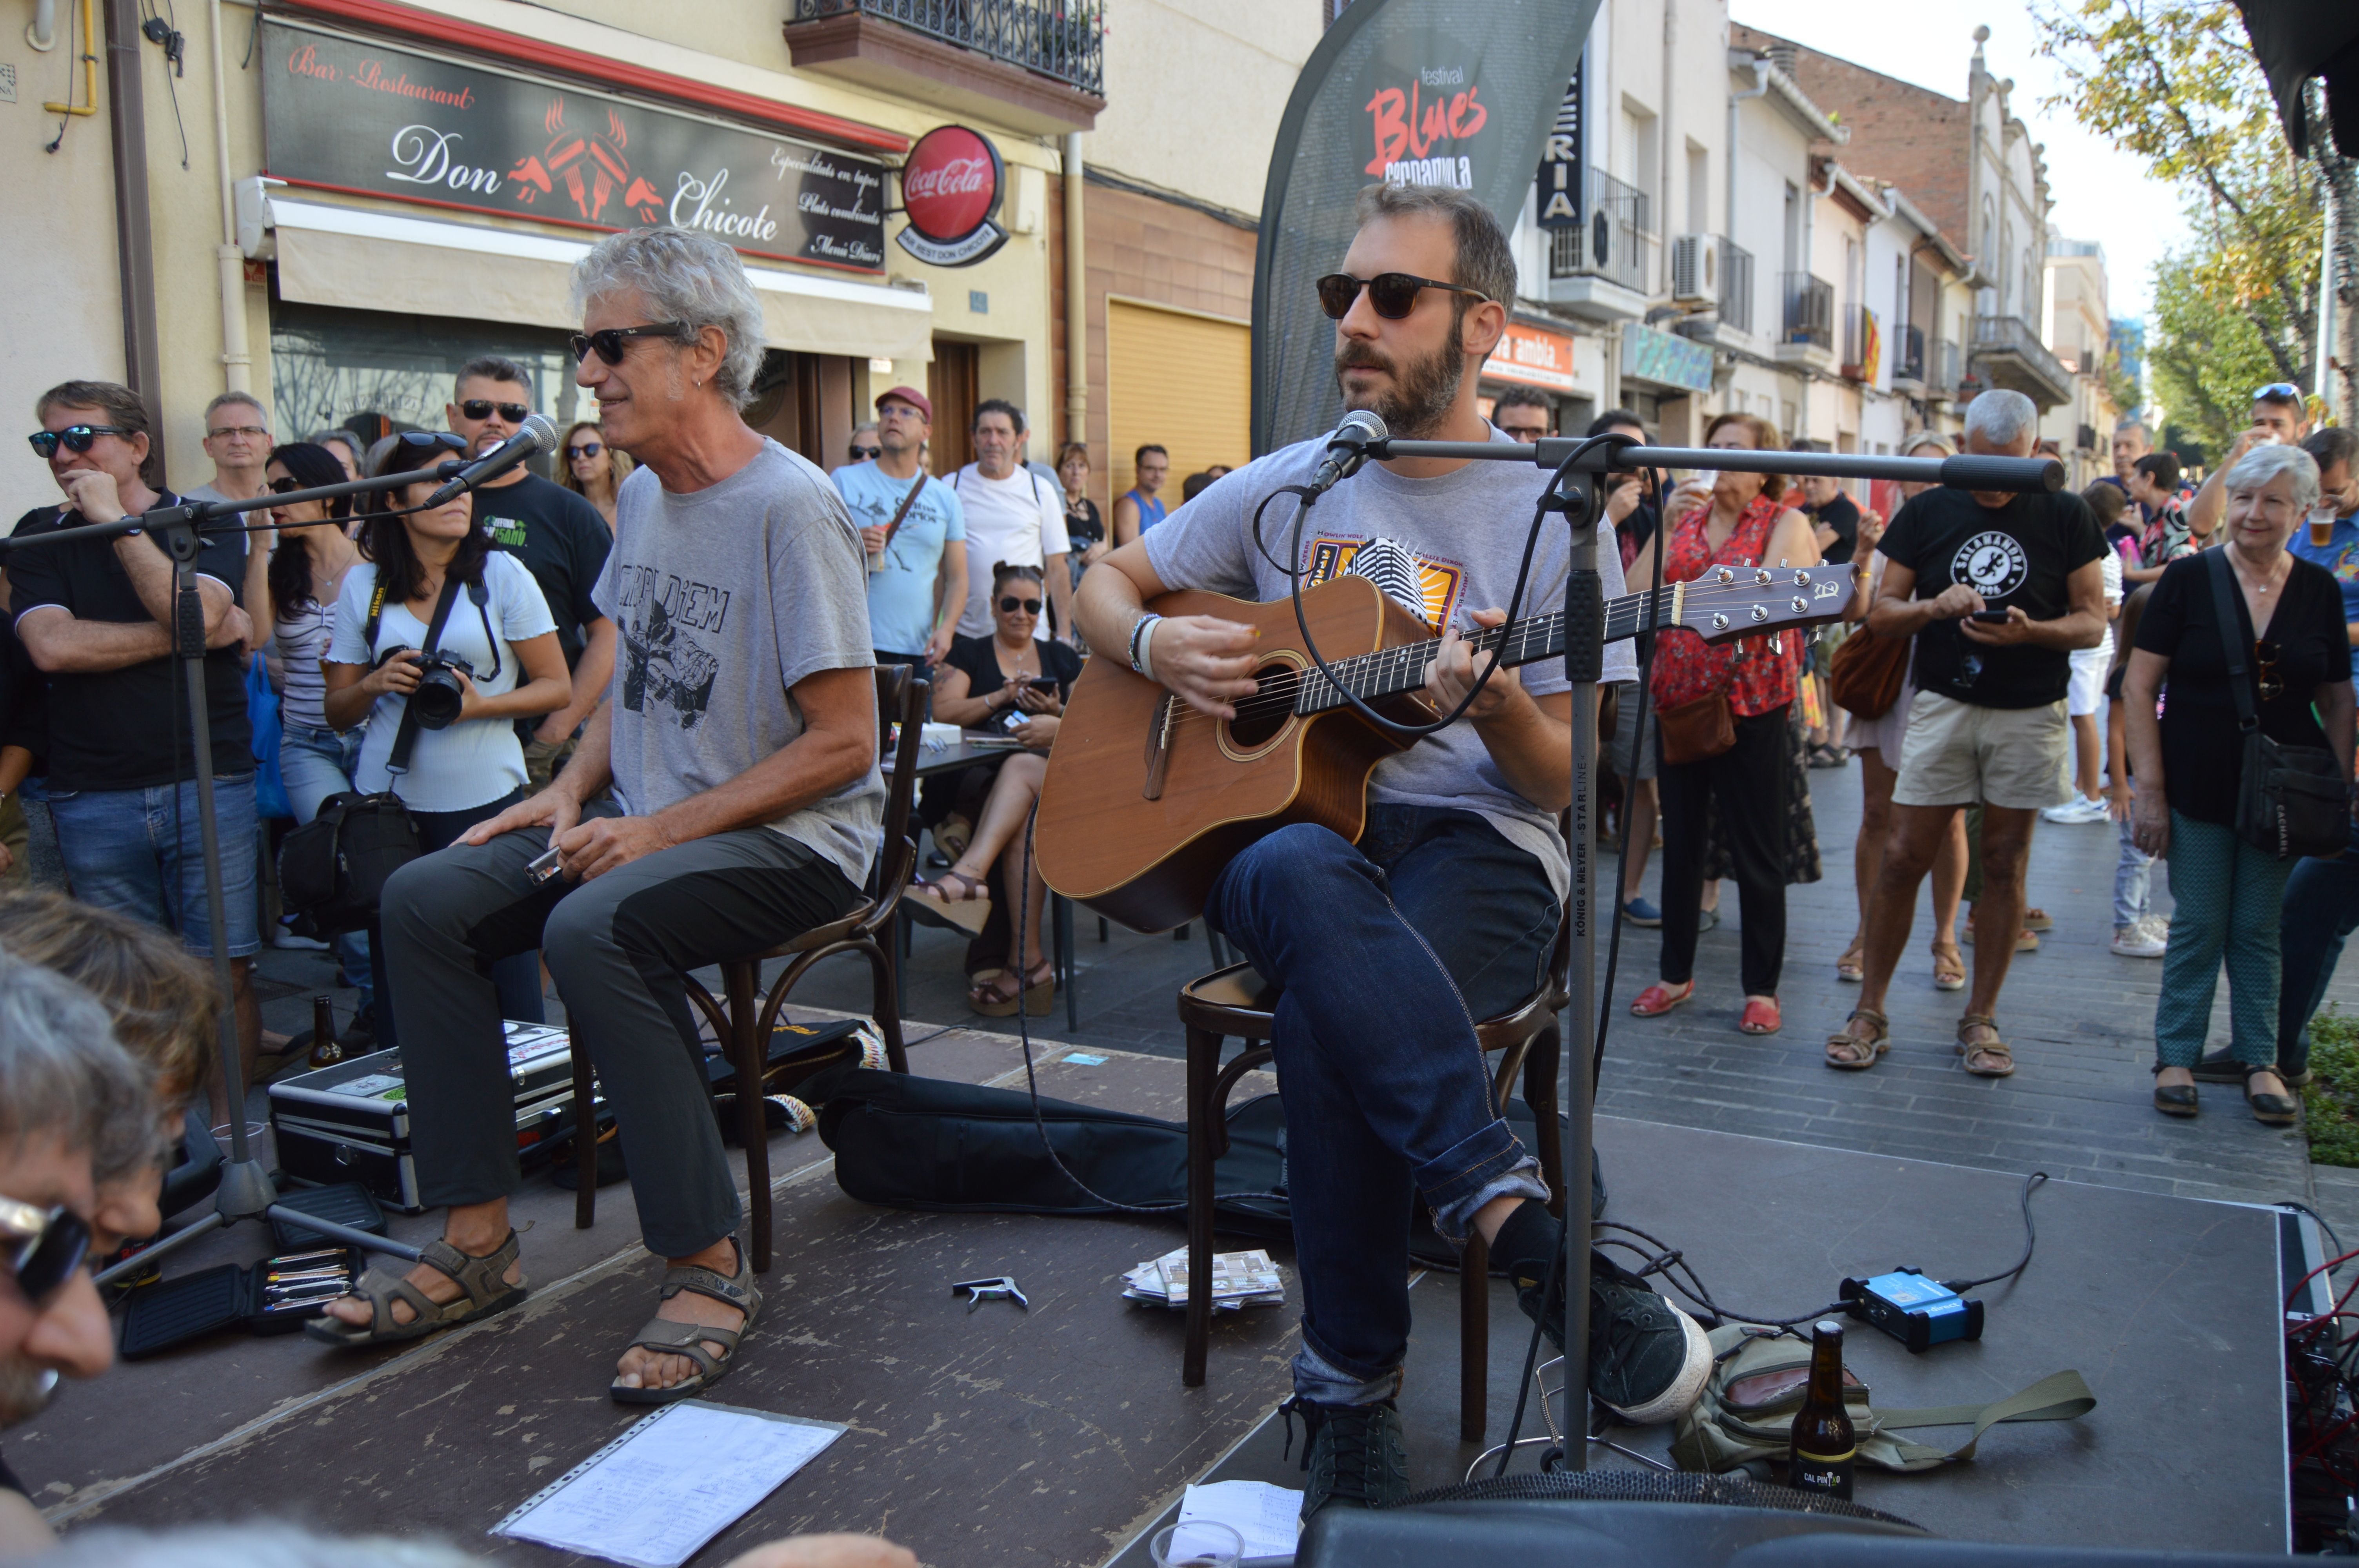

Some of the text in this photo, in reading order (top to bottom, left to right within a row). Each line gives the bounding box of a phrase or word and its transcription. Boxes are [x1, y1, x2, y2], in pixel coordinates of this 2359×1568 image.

[289, 43, 343, 81] Bar
[1421, 65, 1464, 85] festival
[1365, 79, 1487, 179] Blues
[386, 125, 502, 194] Don
[837, 169, 851, 183] en
[854, 169, 880, 197] tapes
[669, 168, 778, 241] Chicote
[798, 192, 830, 216] Plats
[916, 243, 936, 257] REST
[938, 250, 956, 259] DON
[958, 229, 990, 256] CHICOTE
[1415, 550, 1463, 567] WILLIE DIXON
[1955, 534, 2024, 572] SALAMANDRA
[1459, 572, 1468, 598] CHUCK
[371, 587, 384, 617] Nikon
[1577, 842, 1586, 883] MEYER
[1575, 898, 1585, 937] KÖNIG
[1804, 1473, 1816, 1483] CAL
